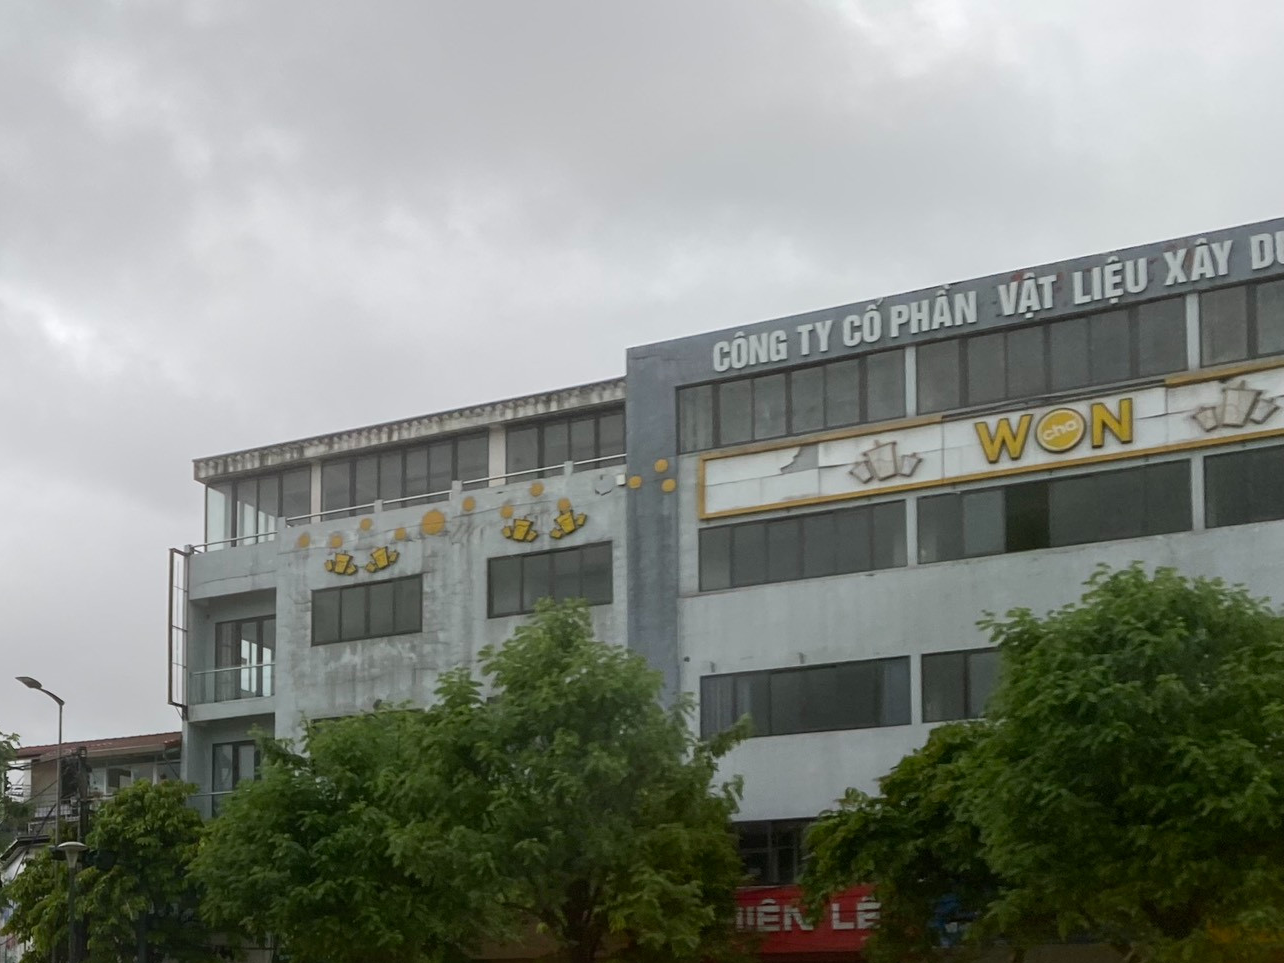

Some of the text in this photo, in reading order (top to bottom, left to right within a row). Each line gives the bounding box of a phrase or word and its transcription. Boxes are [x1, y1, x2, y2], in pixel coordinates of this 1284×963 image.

[713, 330, 787, 372] CÔNG
[797, 320, 833, 356] TY
[890, 284, 978, 338] PHẦN
[998, 272, 1057, 319] VẬT
[1073, 256, 1148, 304] LIỆU
[1163, 237, 1233, 286] XÂY
[974, 397, 1133, 464] WON
